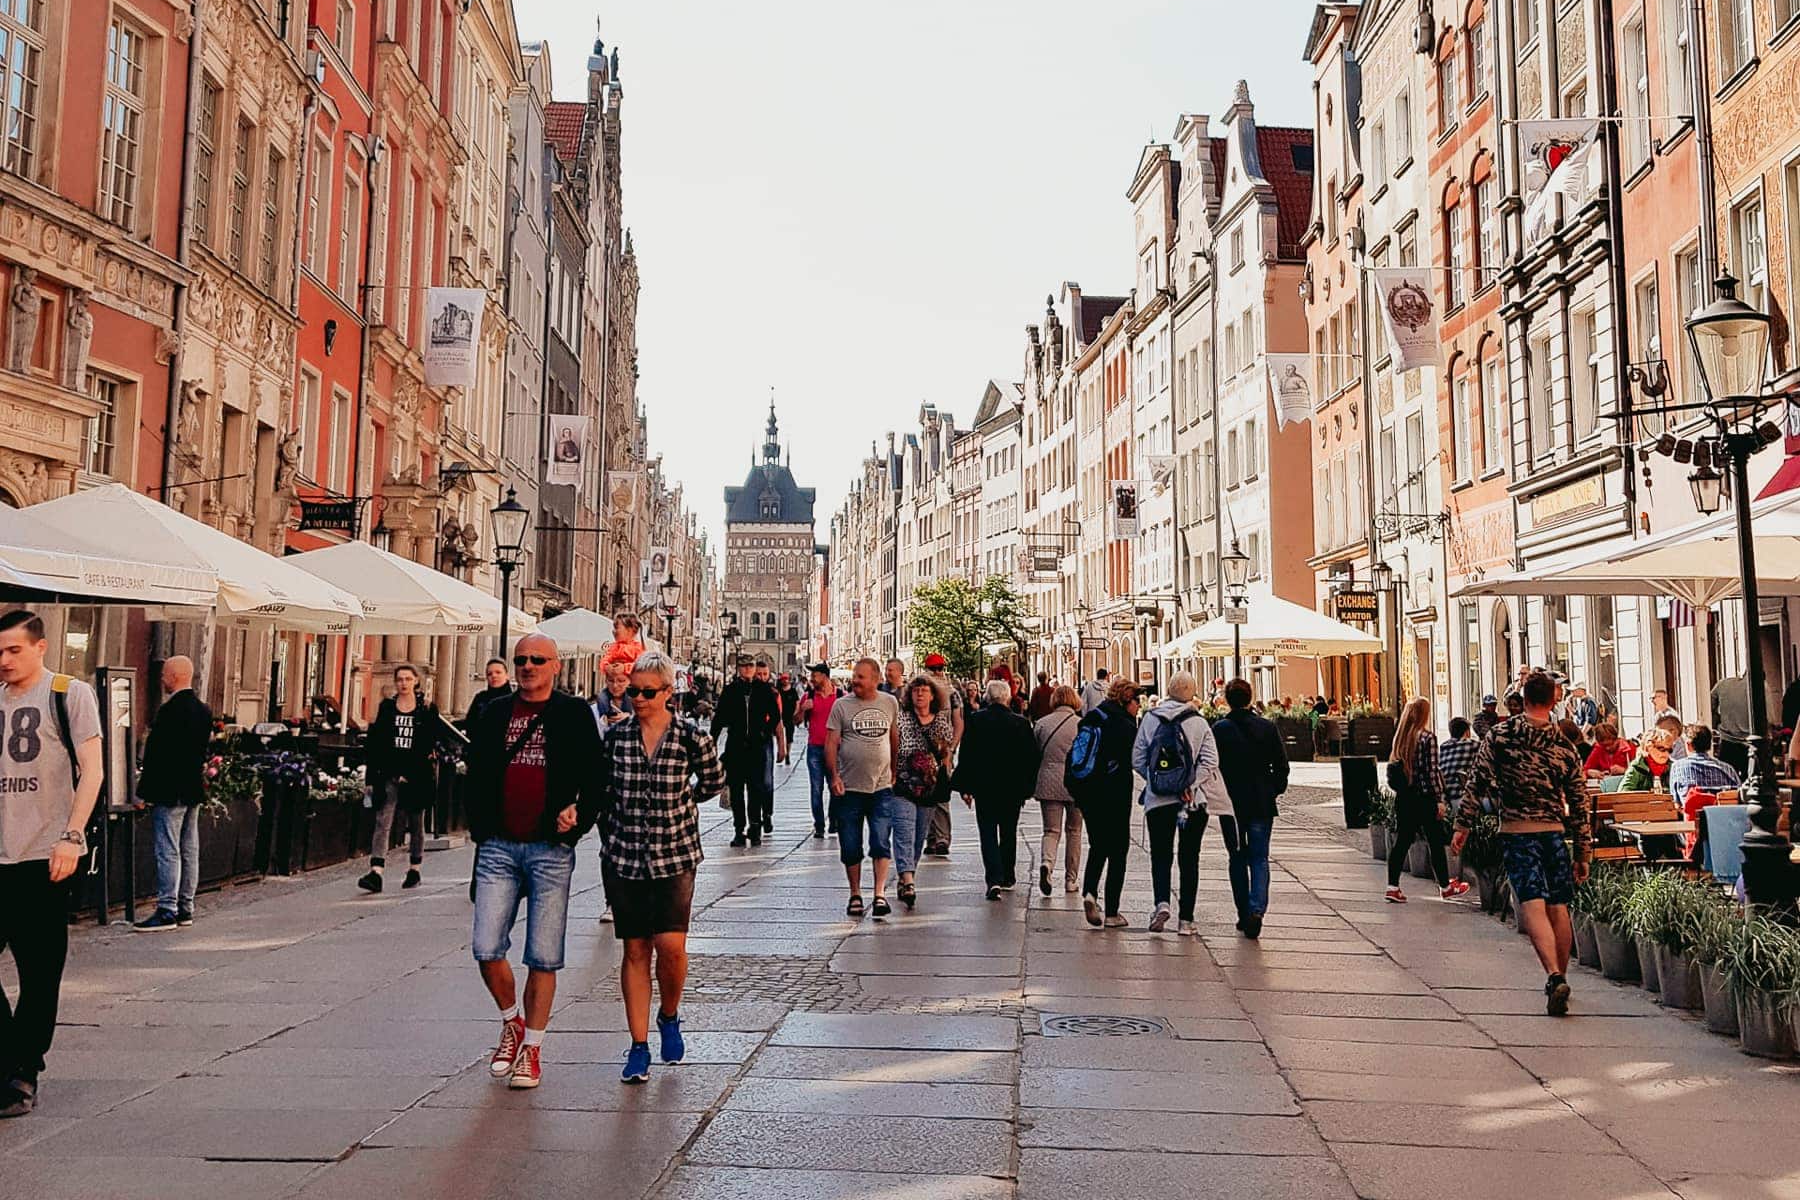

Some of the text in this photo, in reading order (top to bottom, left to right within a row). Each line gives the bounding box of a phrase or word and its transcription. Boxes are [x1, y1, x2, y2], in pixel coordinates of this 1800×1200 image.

[1337, 594, 1377, 609] EXCHANGE
[1341, 612, 1372, 620] KANTOR
[0, 707, 41, 763] 8
[0, 776, 38, 793] ENDS
